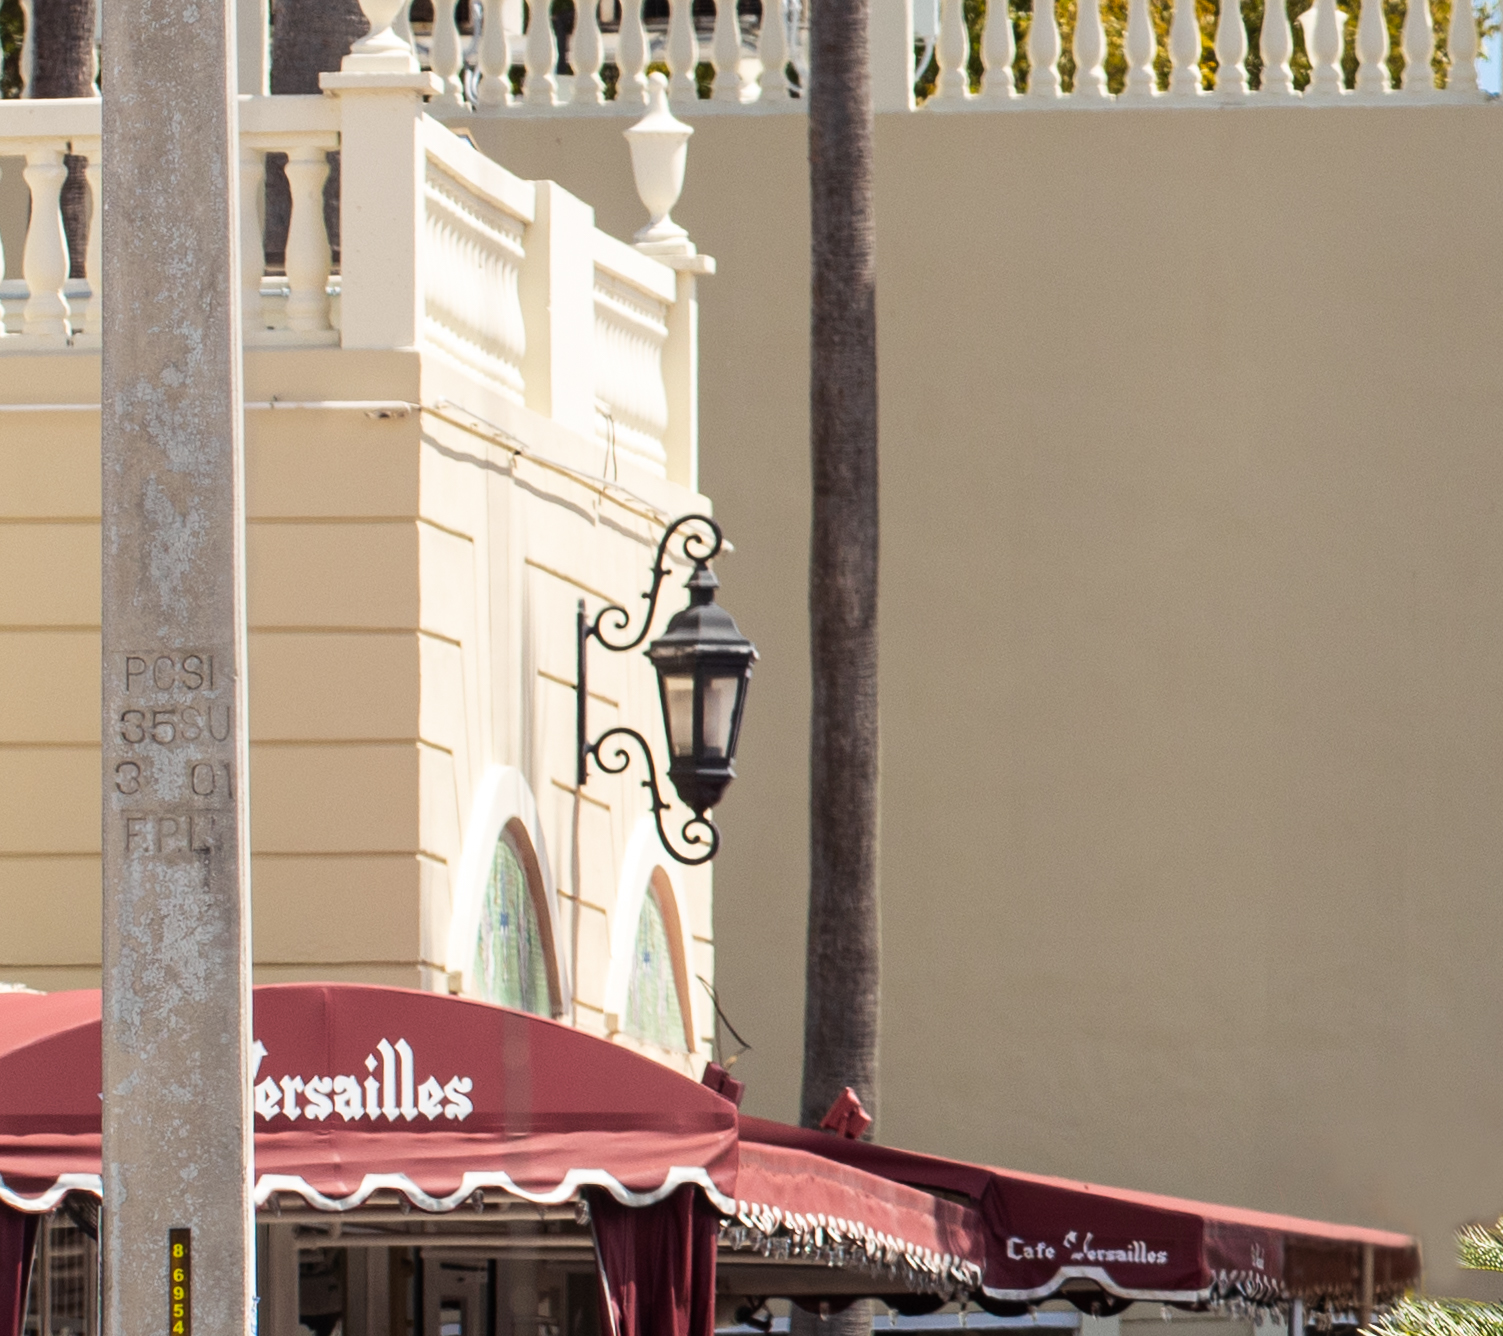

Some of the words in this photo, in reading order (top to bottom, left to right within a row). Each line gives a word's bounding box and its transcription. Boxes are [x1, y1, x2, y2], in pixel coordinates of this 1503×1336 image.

[125, 654, 214, 692] PCSI
[252, 1037, 474, 1122] ersailles
[1006, 1236, 1055, 1260] Cafe
